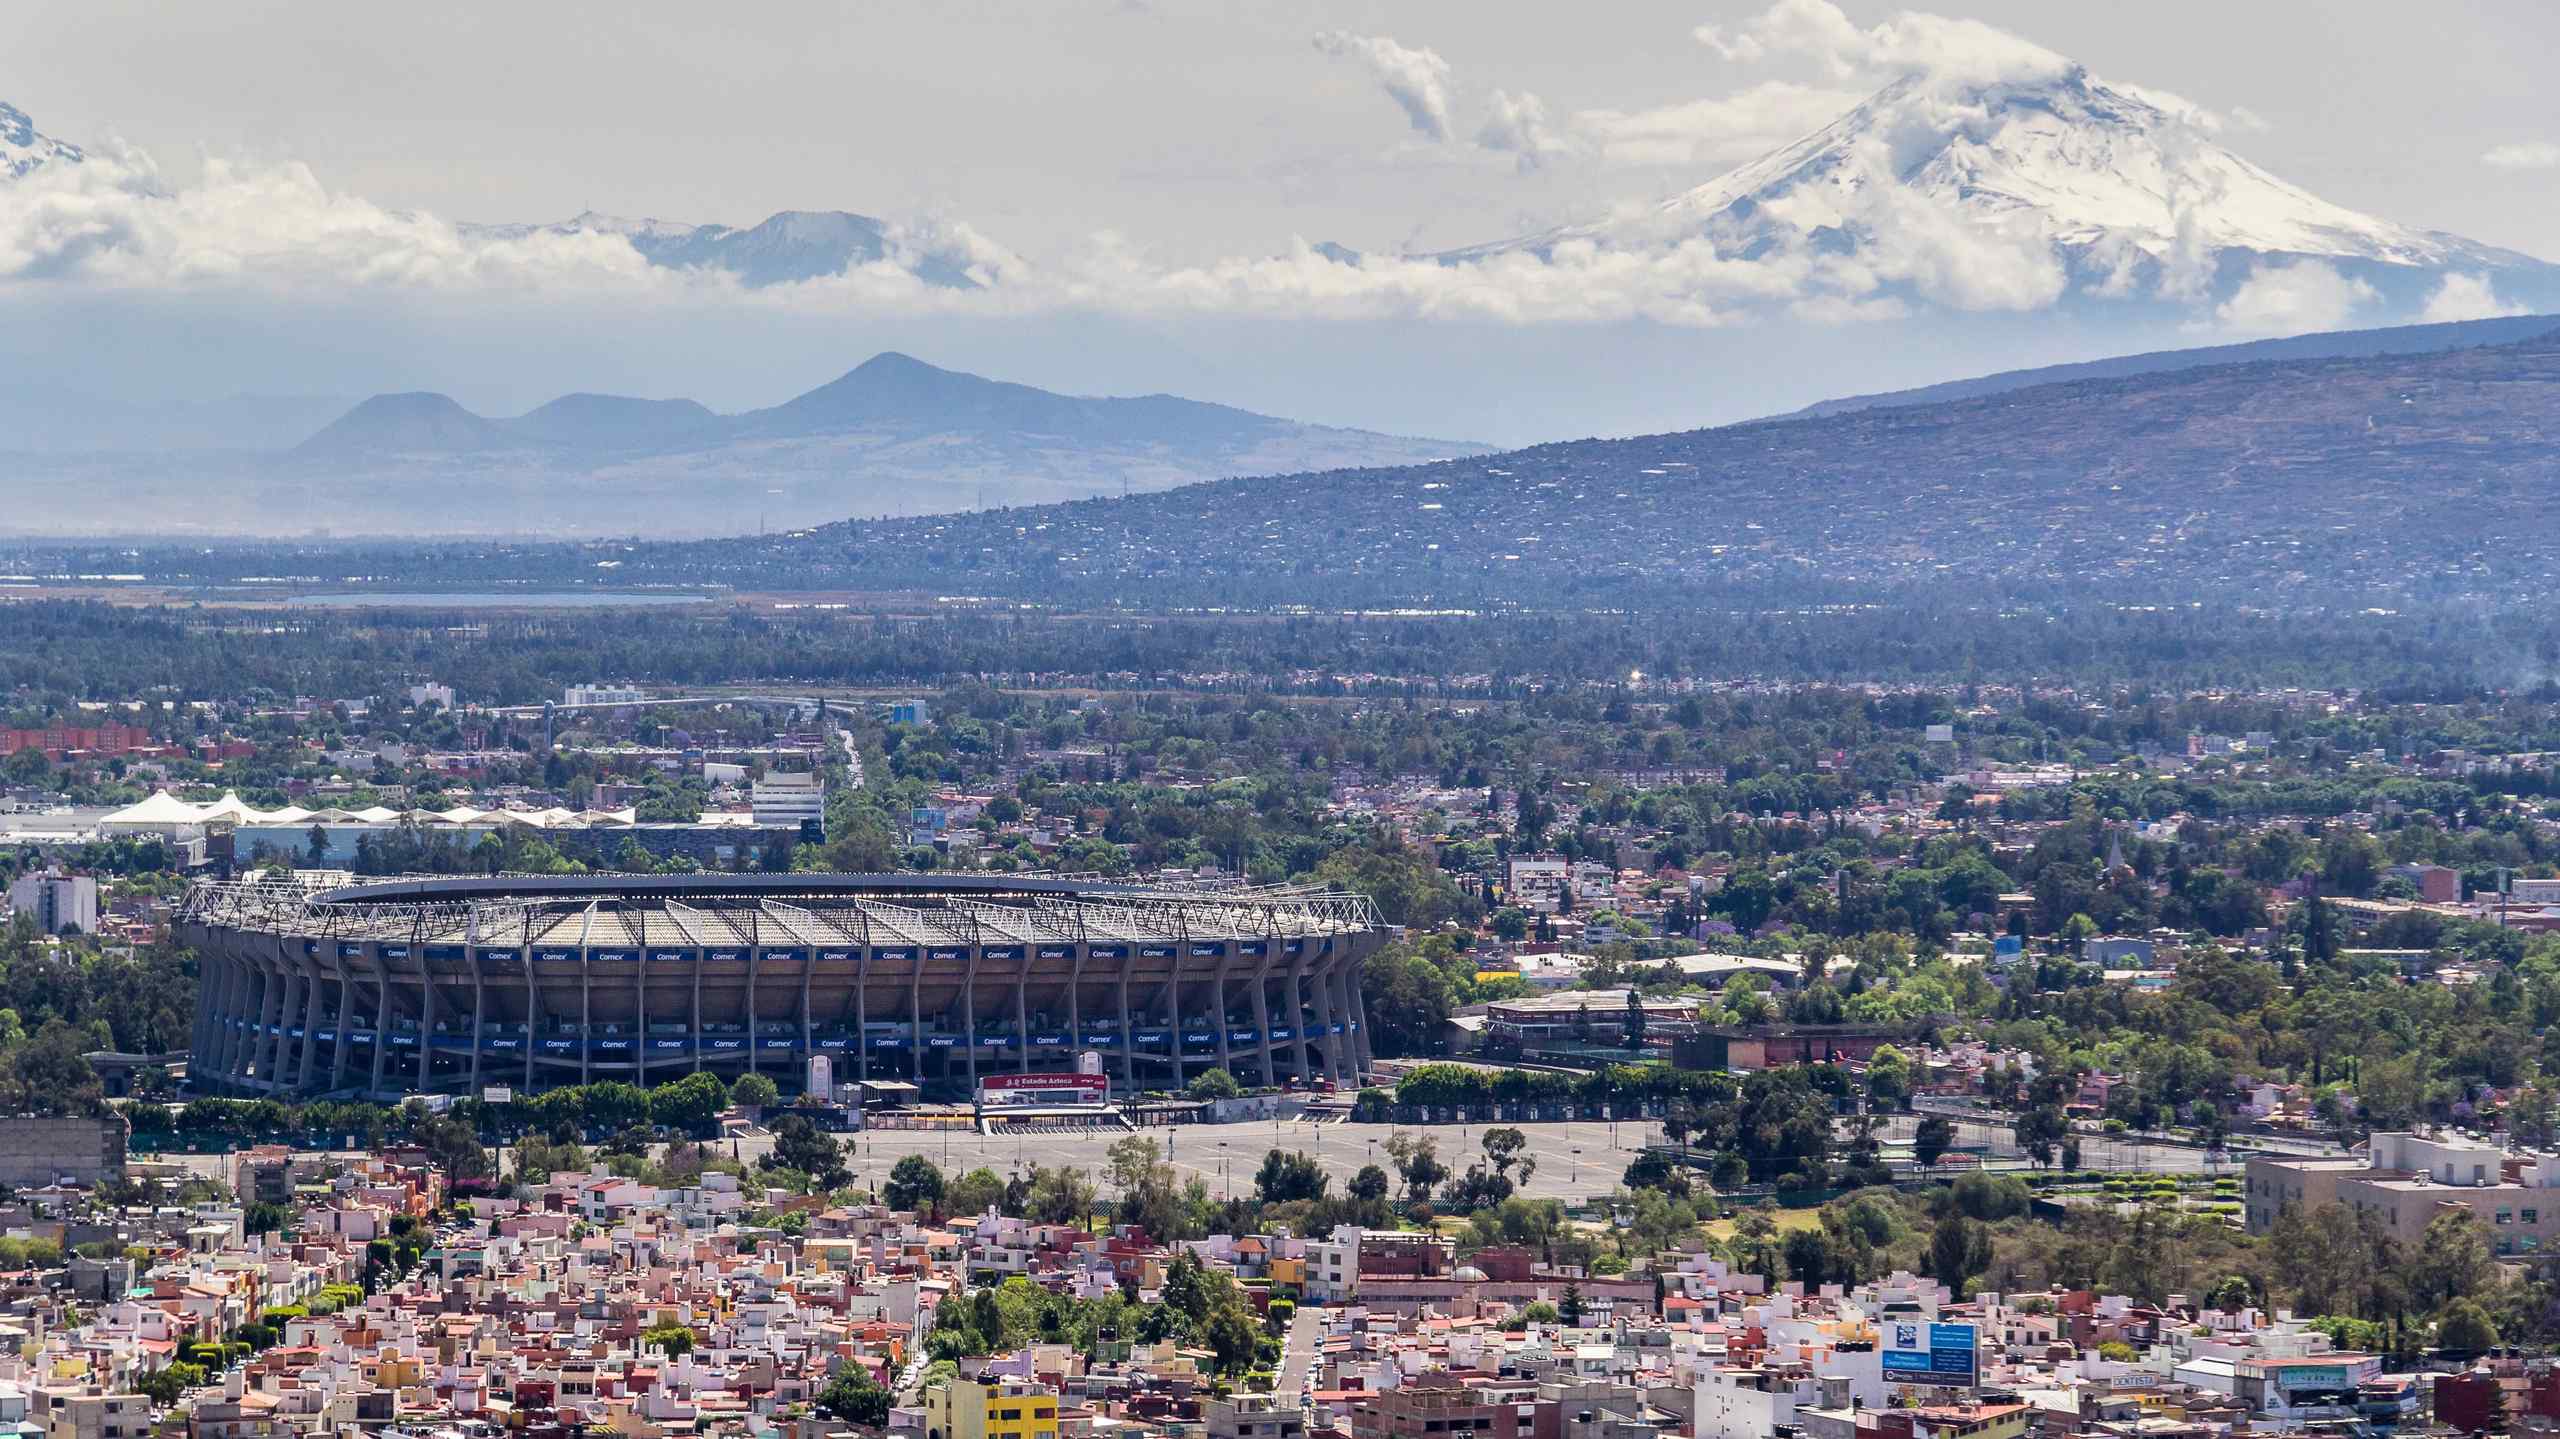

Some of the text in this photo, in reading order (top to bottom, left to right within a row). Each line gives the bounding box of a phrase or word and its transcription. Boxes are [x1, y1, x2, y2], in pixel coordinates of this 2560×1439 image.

[882, 952, 906, 960] Comex
[933, 952, 957, 960] Comex
[1041, 951, 1064, 959] Comex
[1144, 949, 1166, 957] Comex
[1192, 948, 1214, 956] Comex
[393, 1036, 414, 1044] Comex
[930, 1038, 955, 1046] Comex
[984, 1038, 1007, 1046] Comex
[1037, 1036, 1060, 1044] Comex
[1088, 1036, 1112, 1044] Comex
[1137, 1034, 1160, 1042] Comex
[1188, 1034, 1210, 1042] Comex
[493, 1039, 518, 1047] Comex
[546, 1040, 572, 1048] Comex
[602, 1040, 627, 1048] Comex
[657, 1040, 683, 1048] Comex
[714, 1040, 740, 1048] Comex
[767, 1040, 792, 1048] Comex
[821, 1039, 846, 1047] Comex
[876, 1039, 901, 1047] Comex
